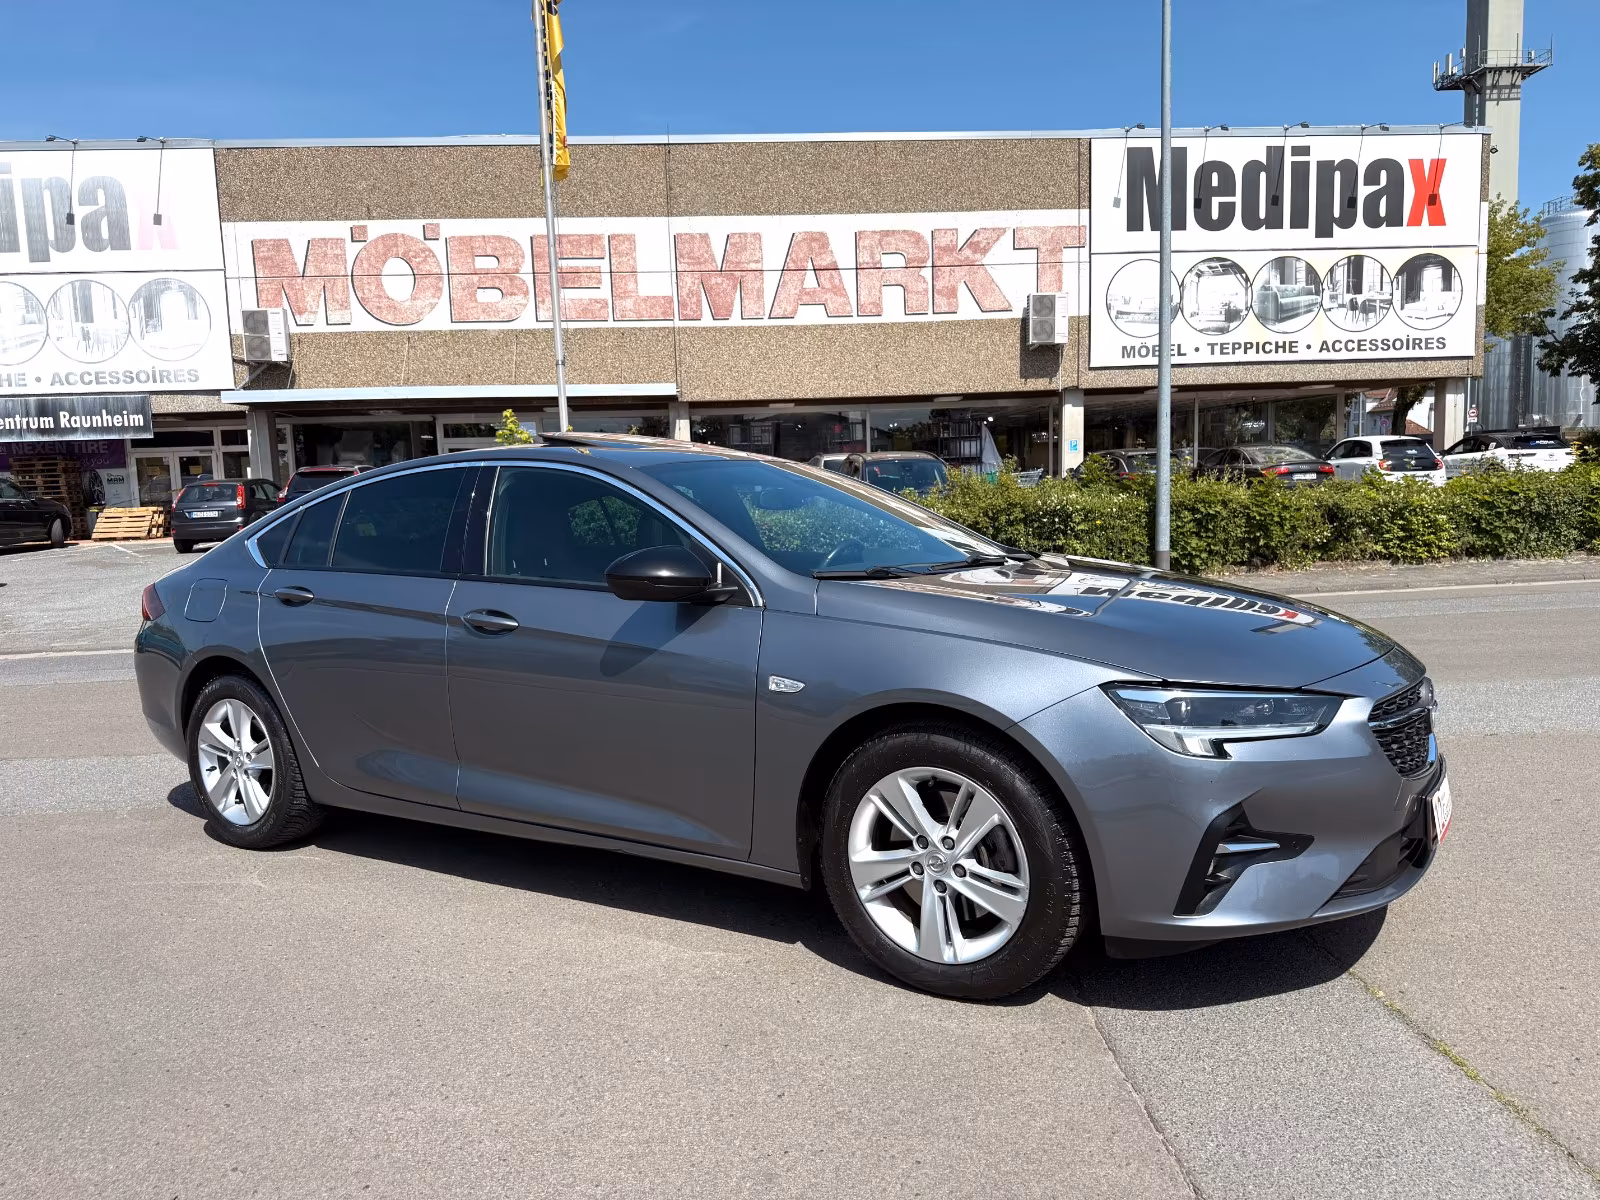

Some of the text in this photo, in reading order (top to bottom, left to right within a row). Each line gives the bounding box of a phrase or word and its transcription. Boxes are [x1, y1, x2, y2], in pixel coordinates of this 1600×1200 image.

[1126, 145, 1447, 238] Medipax
[252, 223, 1087, 325] MÖBELMARKT
[1207, 341, 1299, 356] TEPPICHE
[59, 409, 144, 428] Raunheim
[11, 441, 67, 455] NEXEN
[71, 440, 108, 454] TIRE
